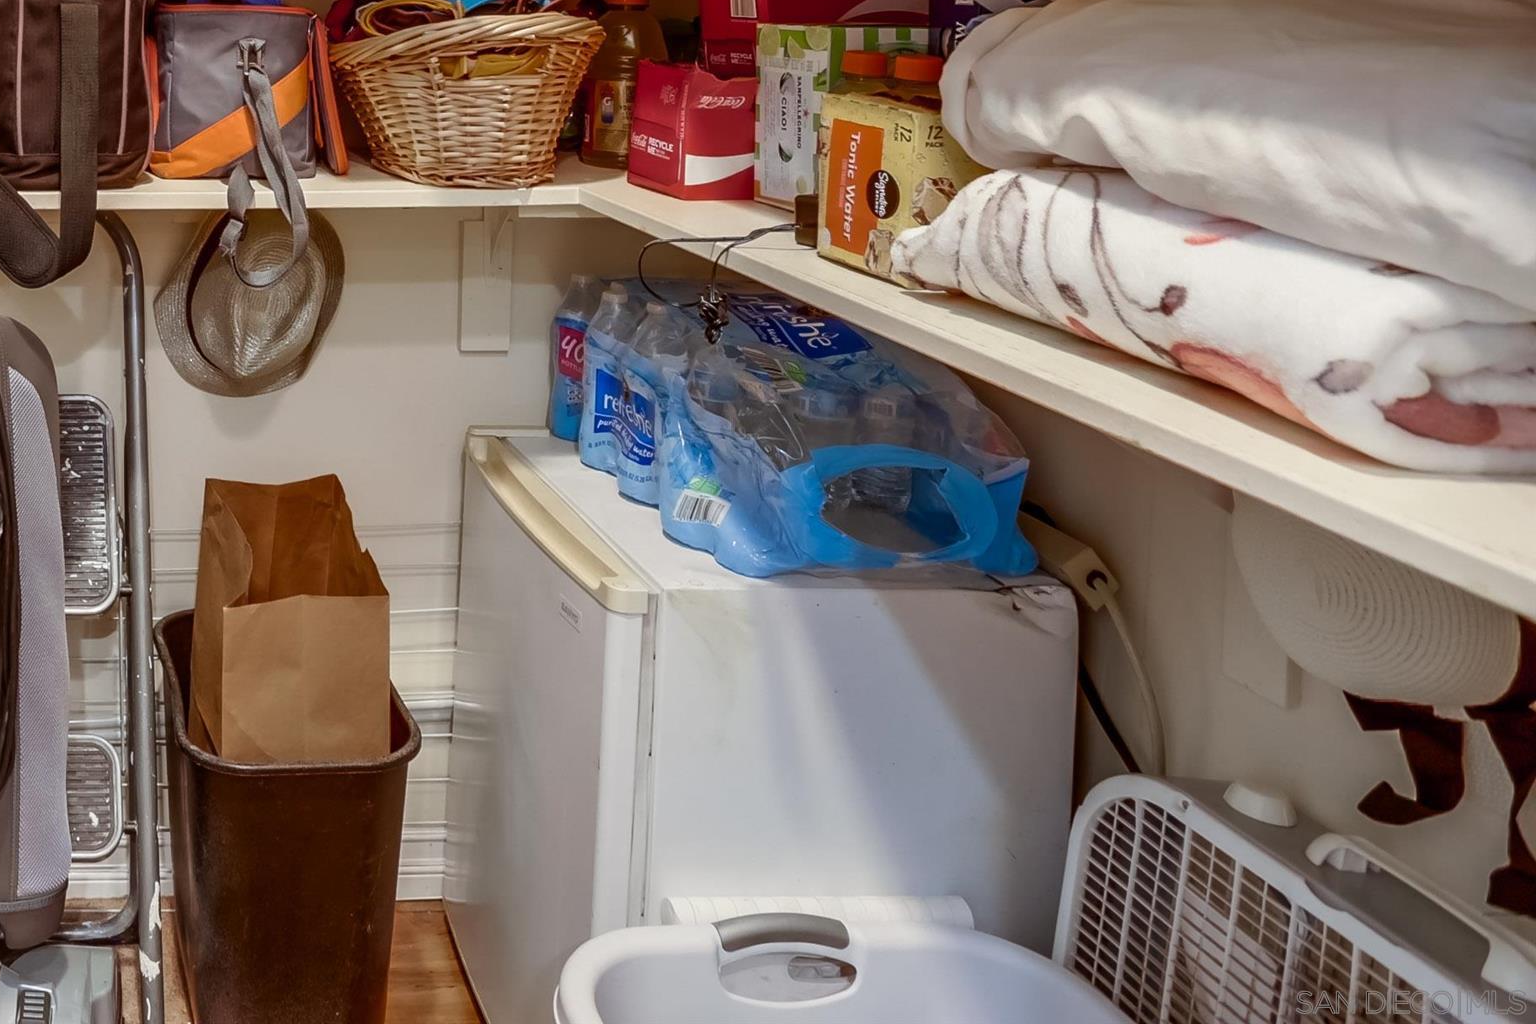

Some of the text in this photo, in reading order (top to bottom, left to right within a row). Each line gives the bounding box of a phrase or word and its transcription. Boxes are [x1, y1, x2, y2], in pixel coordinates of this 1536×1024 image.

[648, 136, 674, 153] RECYCLE
[899, 125, 913, 143] 12
[927, 125, 944, 141] 12
[848, 131, 861, 179] Tonic
[877, 171, 889, 218] Signature
[843, 184, 856, 242] Water
